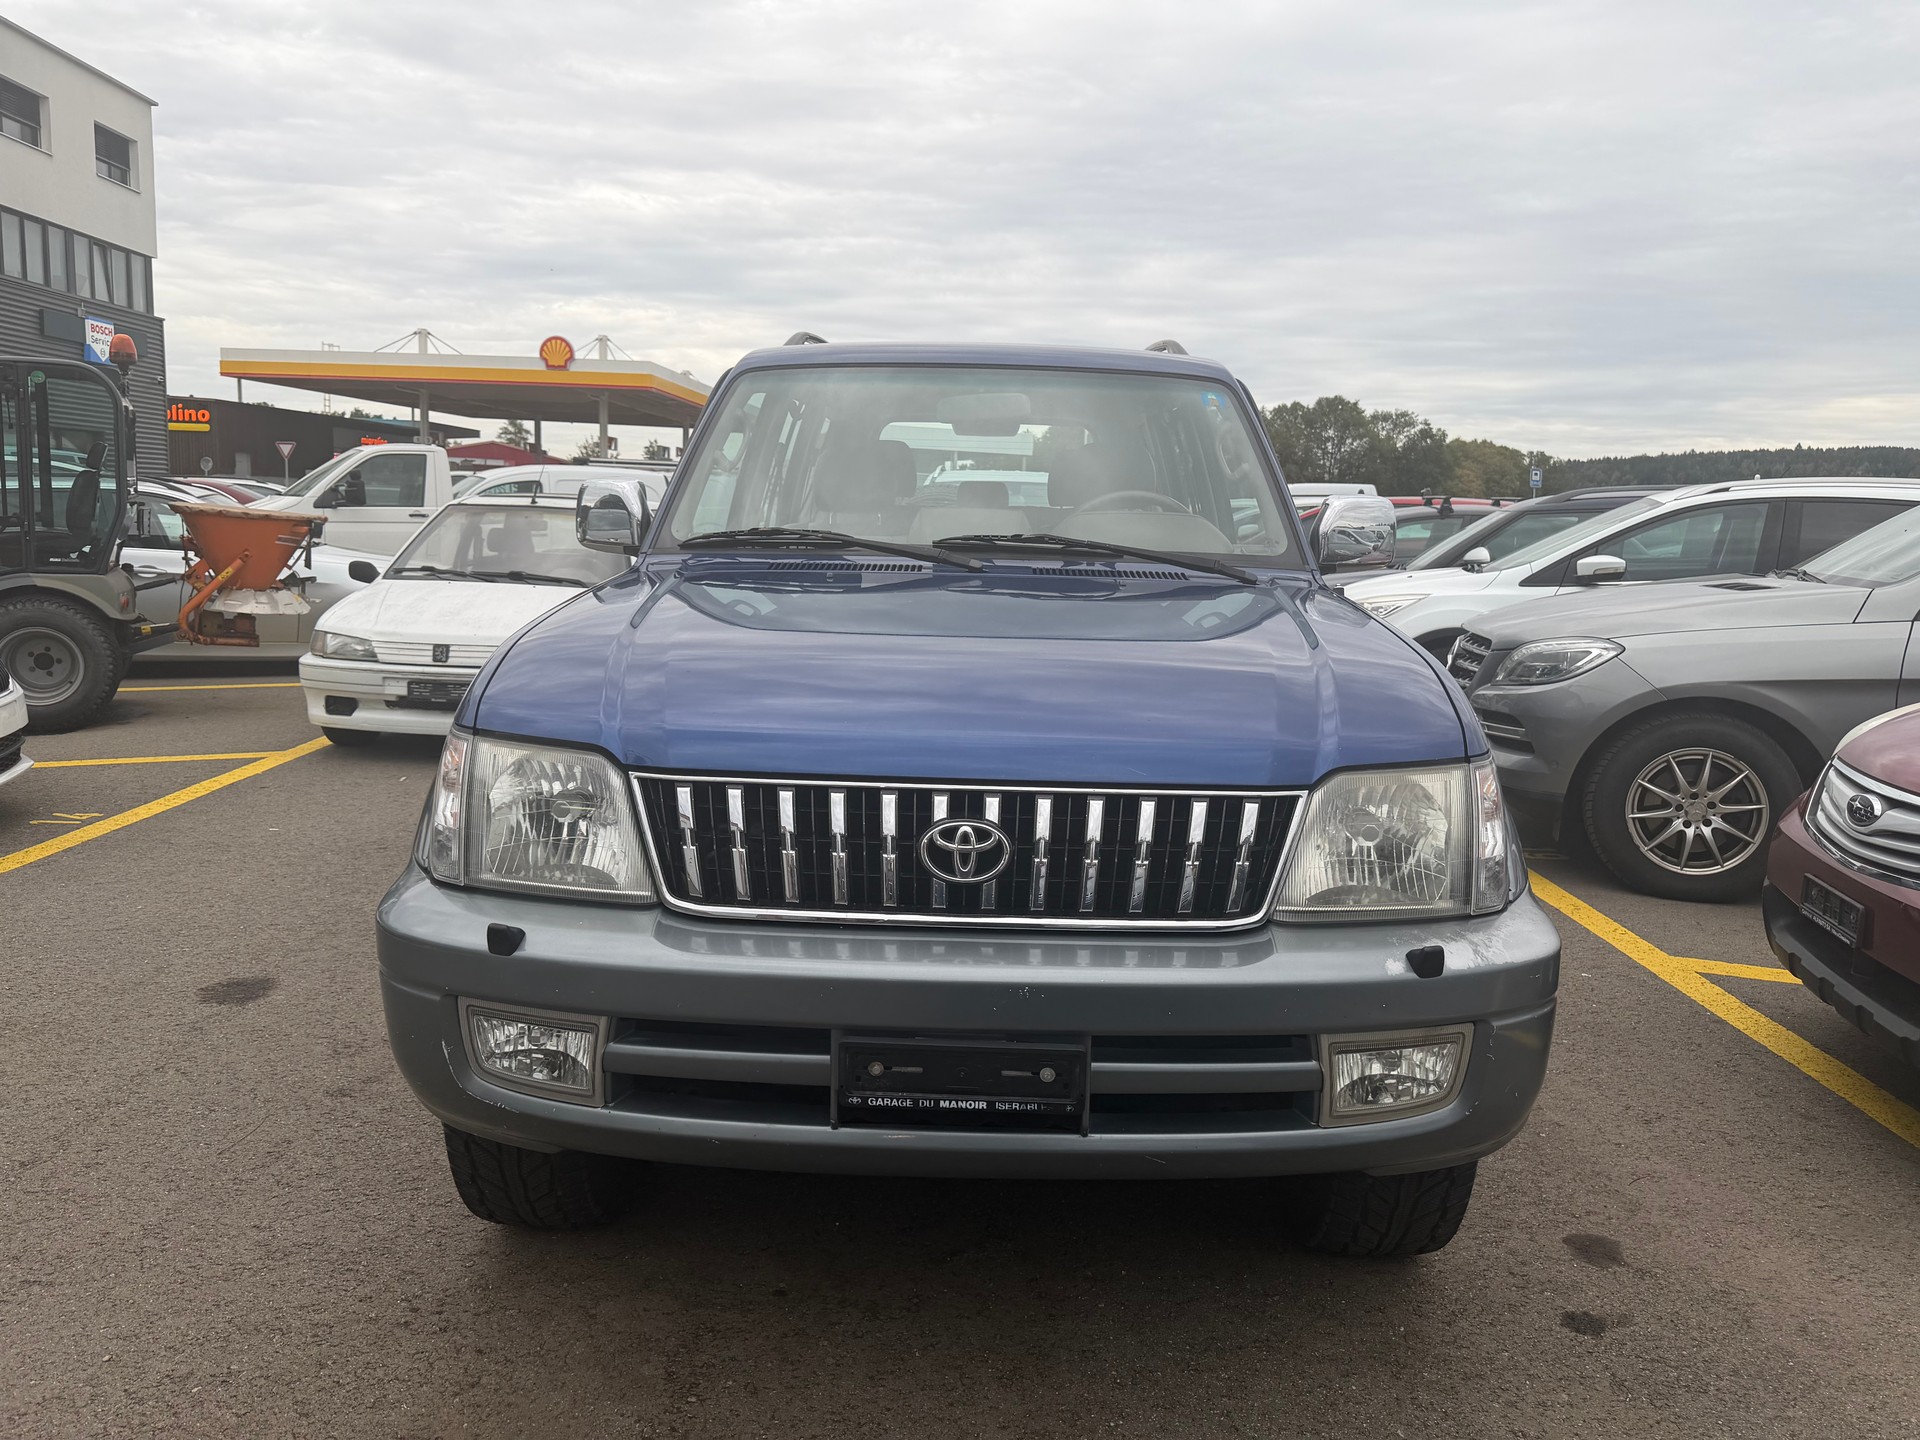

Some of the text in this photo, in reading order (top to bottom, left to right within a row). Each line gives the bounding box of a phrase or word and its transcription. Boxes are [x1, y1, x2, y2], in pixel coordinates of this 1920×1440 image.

[90, 323, 113, 337] BOSCH
[90, 334, 110, 347] Servic
[868, 1097, 914, 1108] GARAGE
[919, 1099, 934, 1108] DU
[939, 1100, 987, 1110] MANOIR
